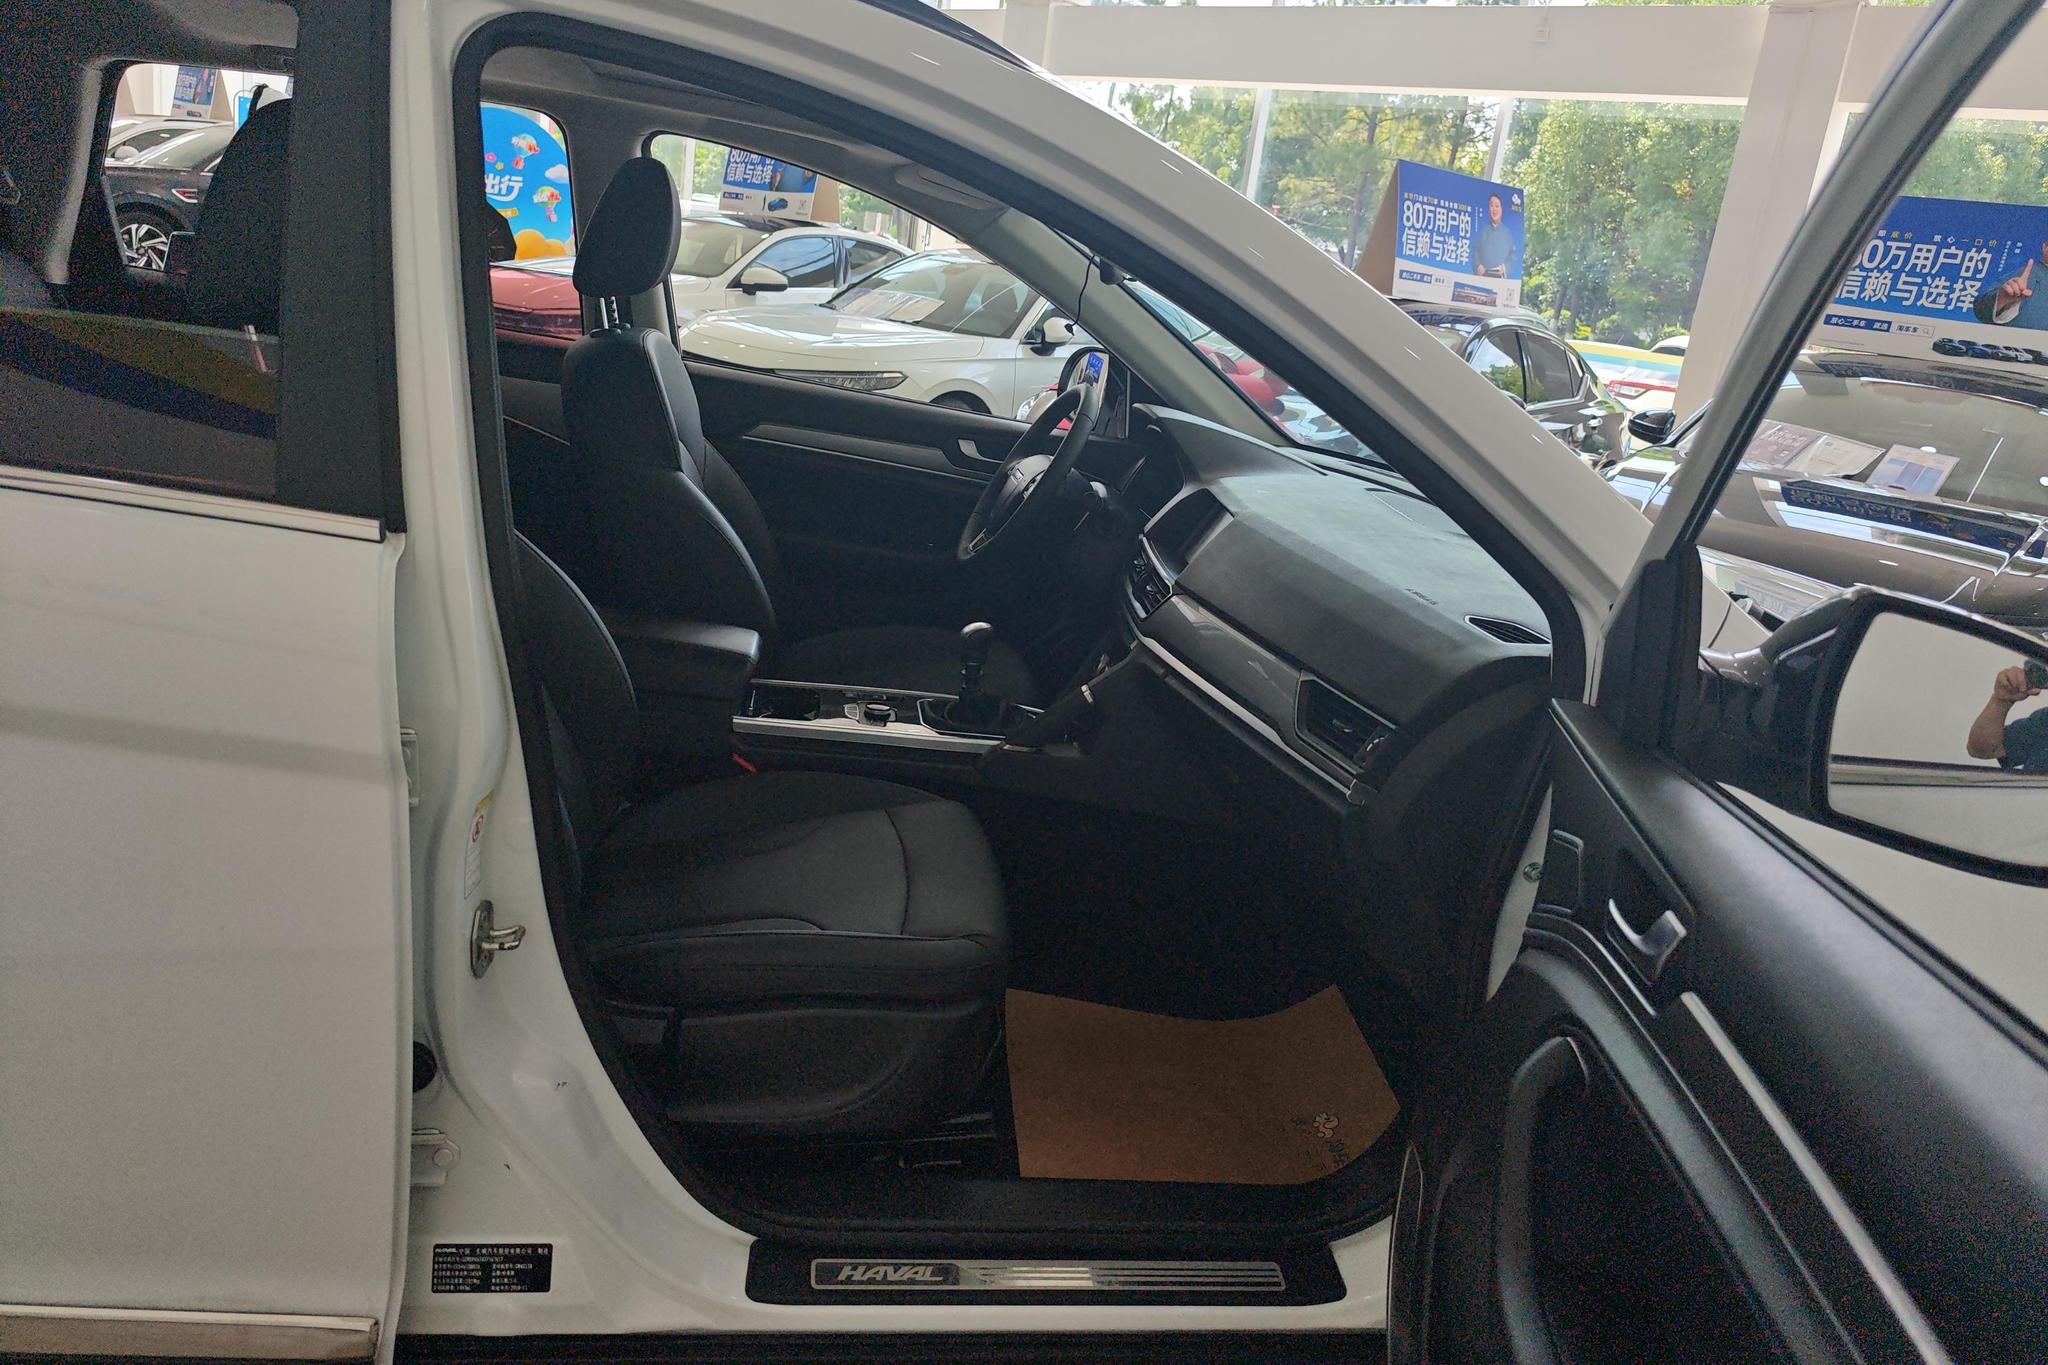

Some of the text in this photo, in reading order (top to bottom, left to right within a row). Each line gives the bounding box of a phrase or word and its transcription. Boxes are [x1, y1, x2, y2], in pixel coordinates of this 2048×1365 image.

[727, 163, 772, 184] 信赖与选择
[1403, 200, 1471, 237] 80万用户的
[1402, 227, 1470, 265] 信赖与选择
[1852, 239, 1993, 280] 0万用户的
[1835, 269, 1982, 313] 信赖与选择
[1829, 315, 1867, 328] 放心二手车
[837, 1265, 944, 1281] HAVAL
